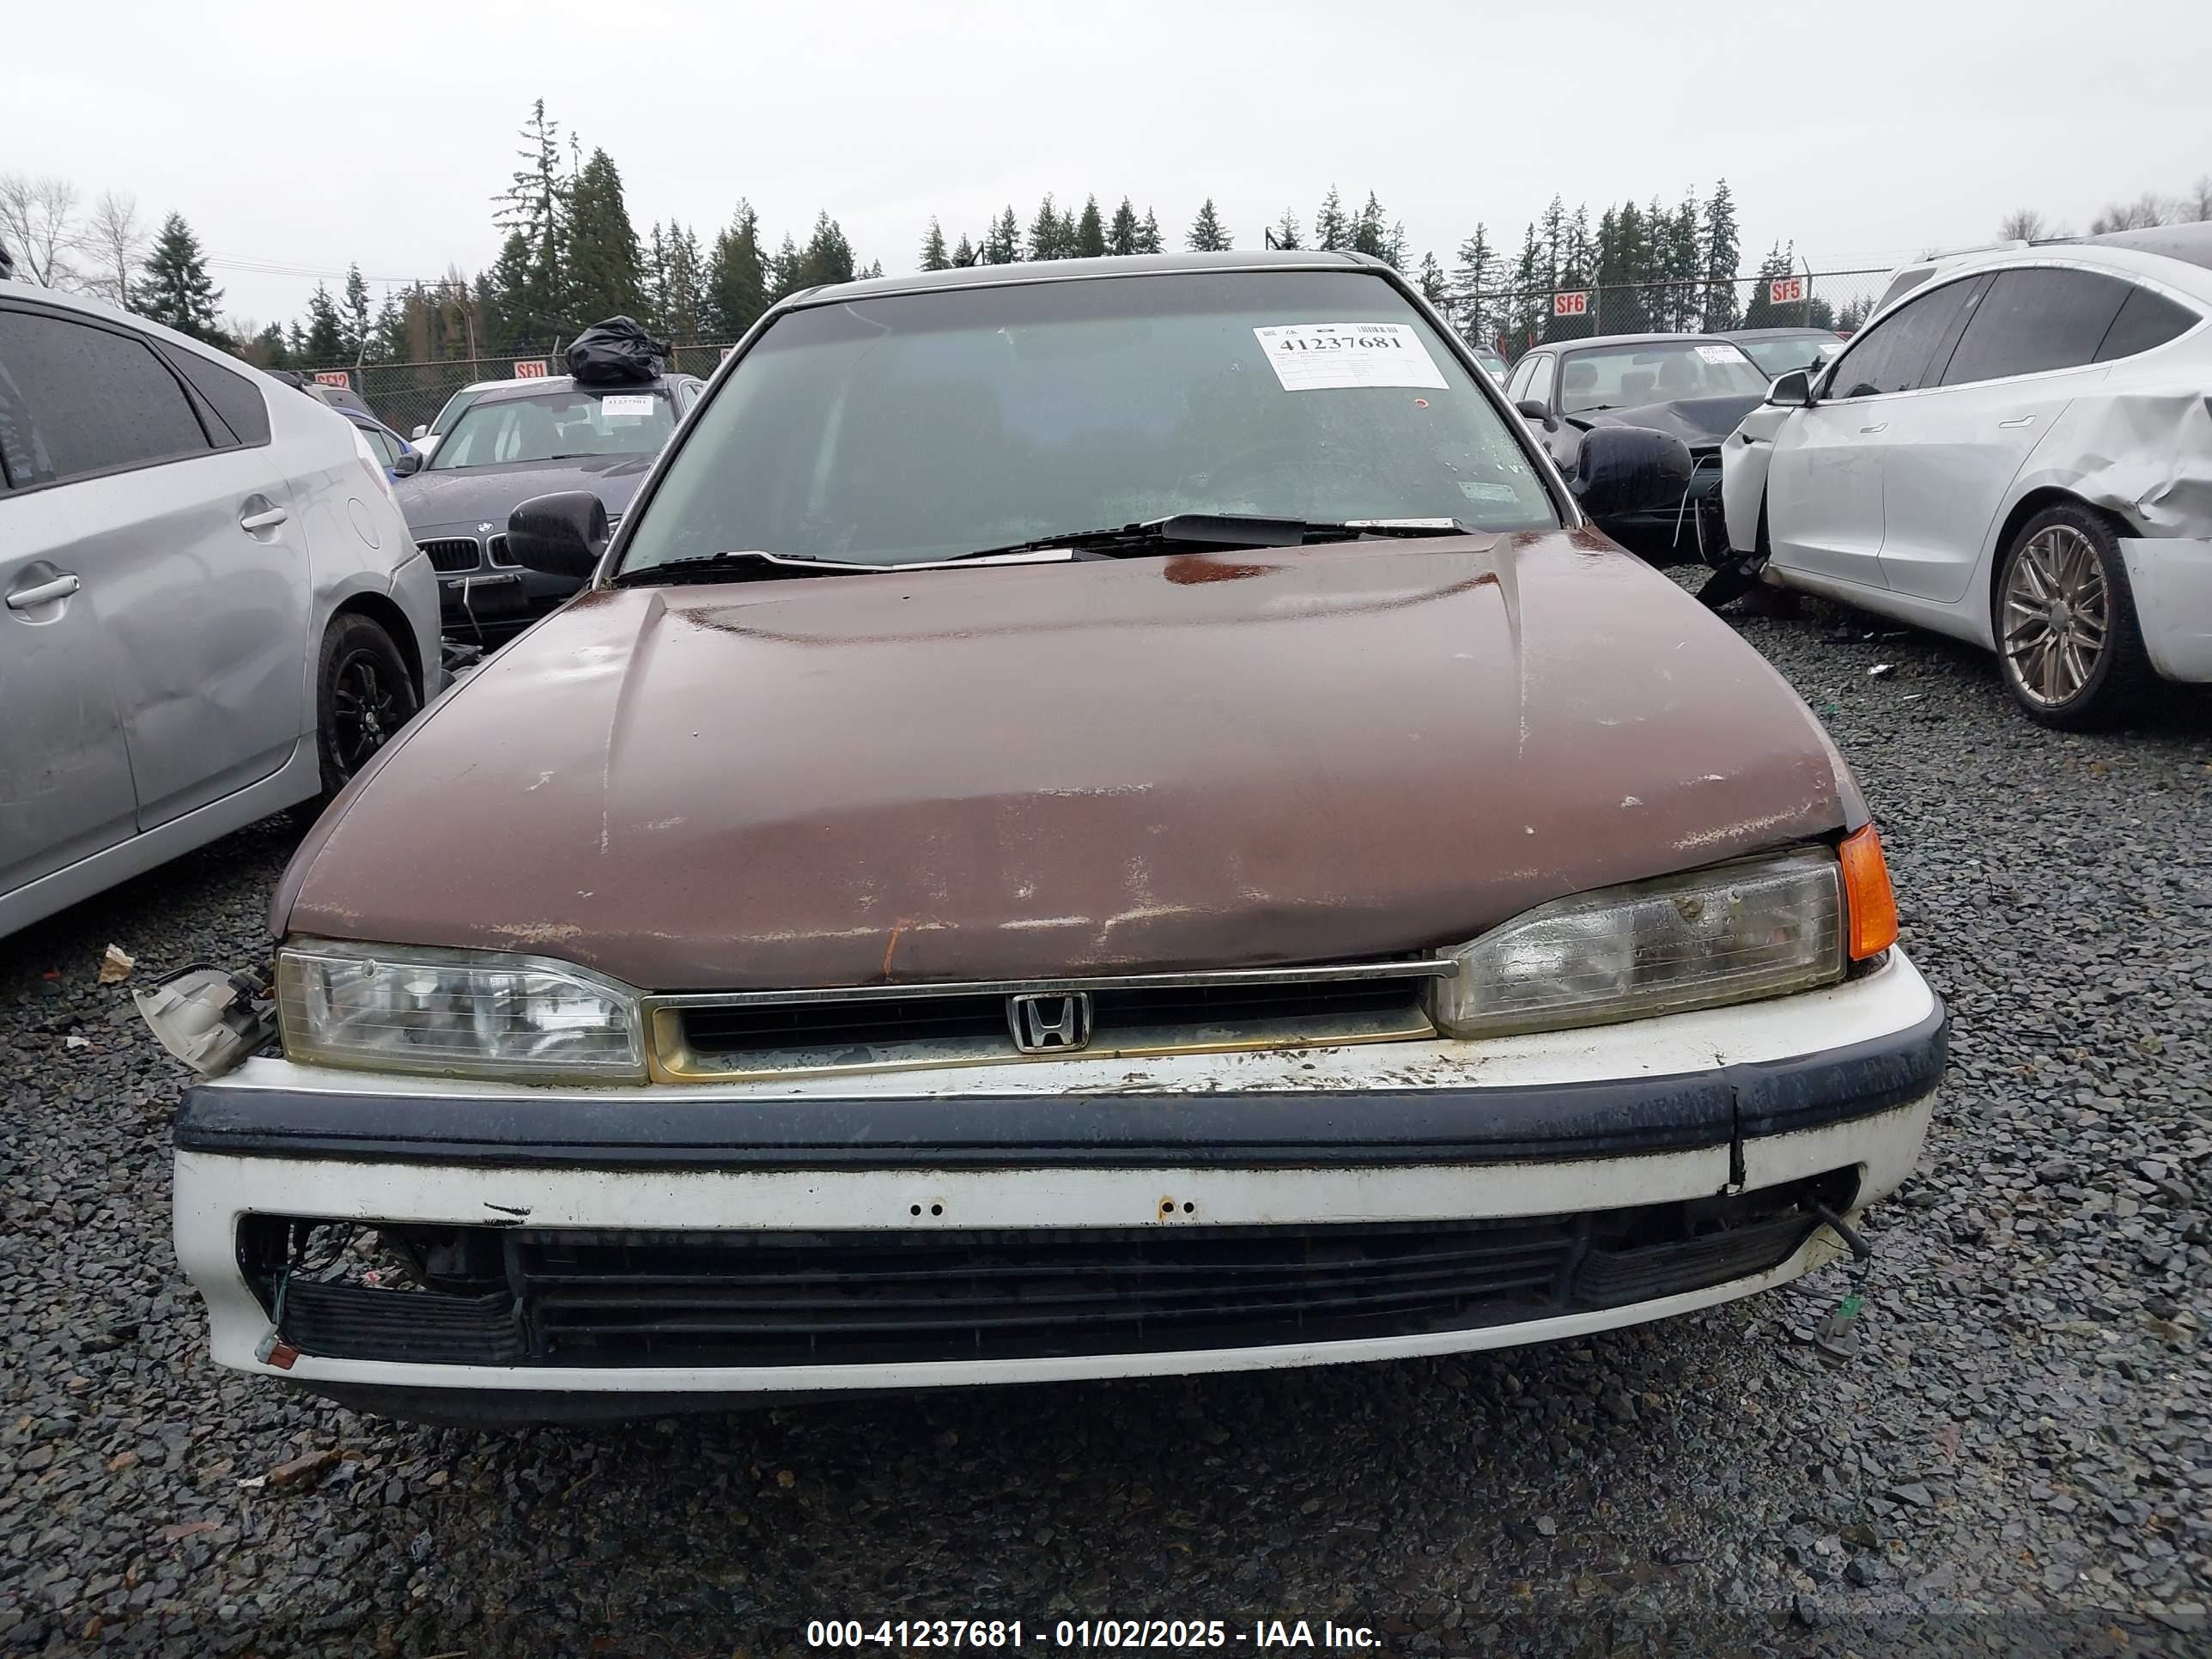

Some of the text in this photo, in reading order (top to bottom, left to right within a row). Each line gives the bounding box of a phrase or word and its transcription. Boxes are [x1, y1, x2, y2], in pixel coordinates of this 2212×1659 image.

[1772, 281, 1801, 301] SF5
[1556, 294, 1584, 314] SF6
[1279, 336, 1403, 351] 41237681
[517, 362, 544, 379] SF11
